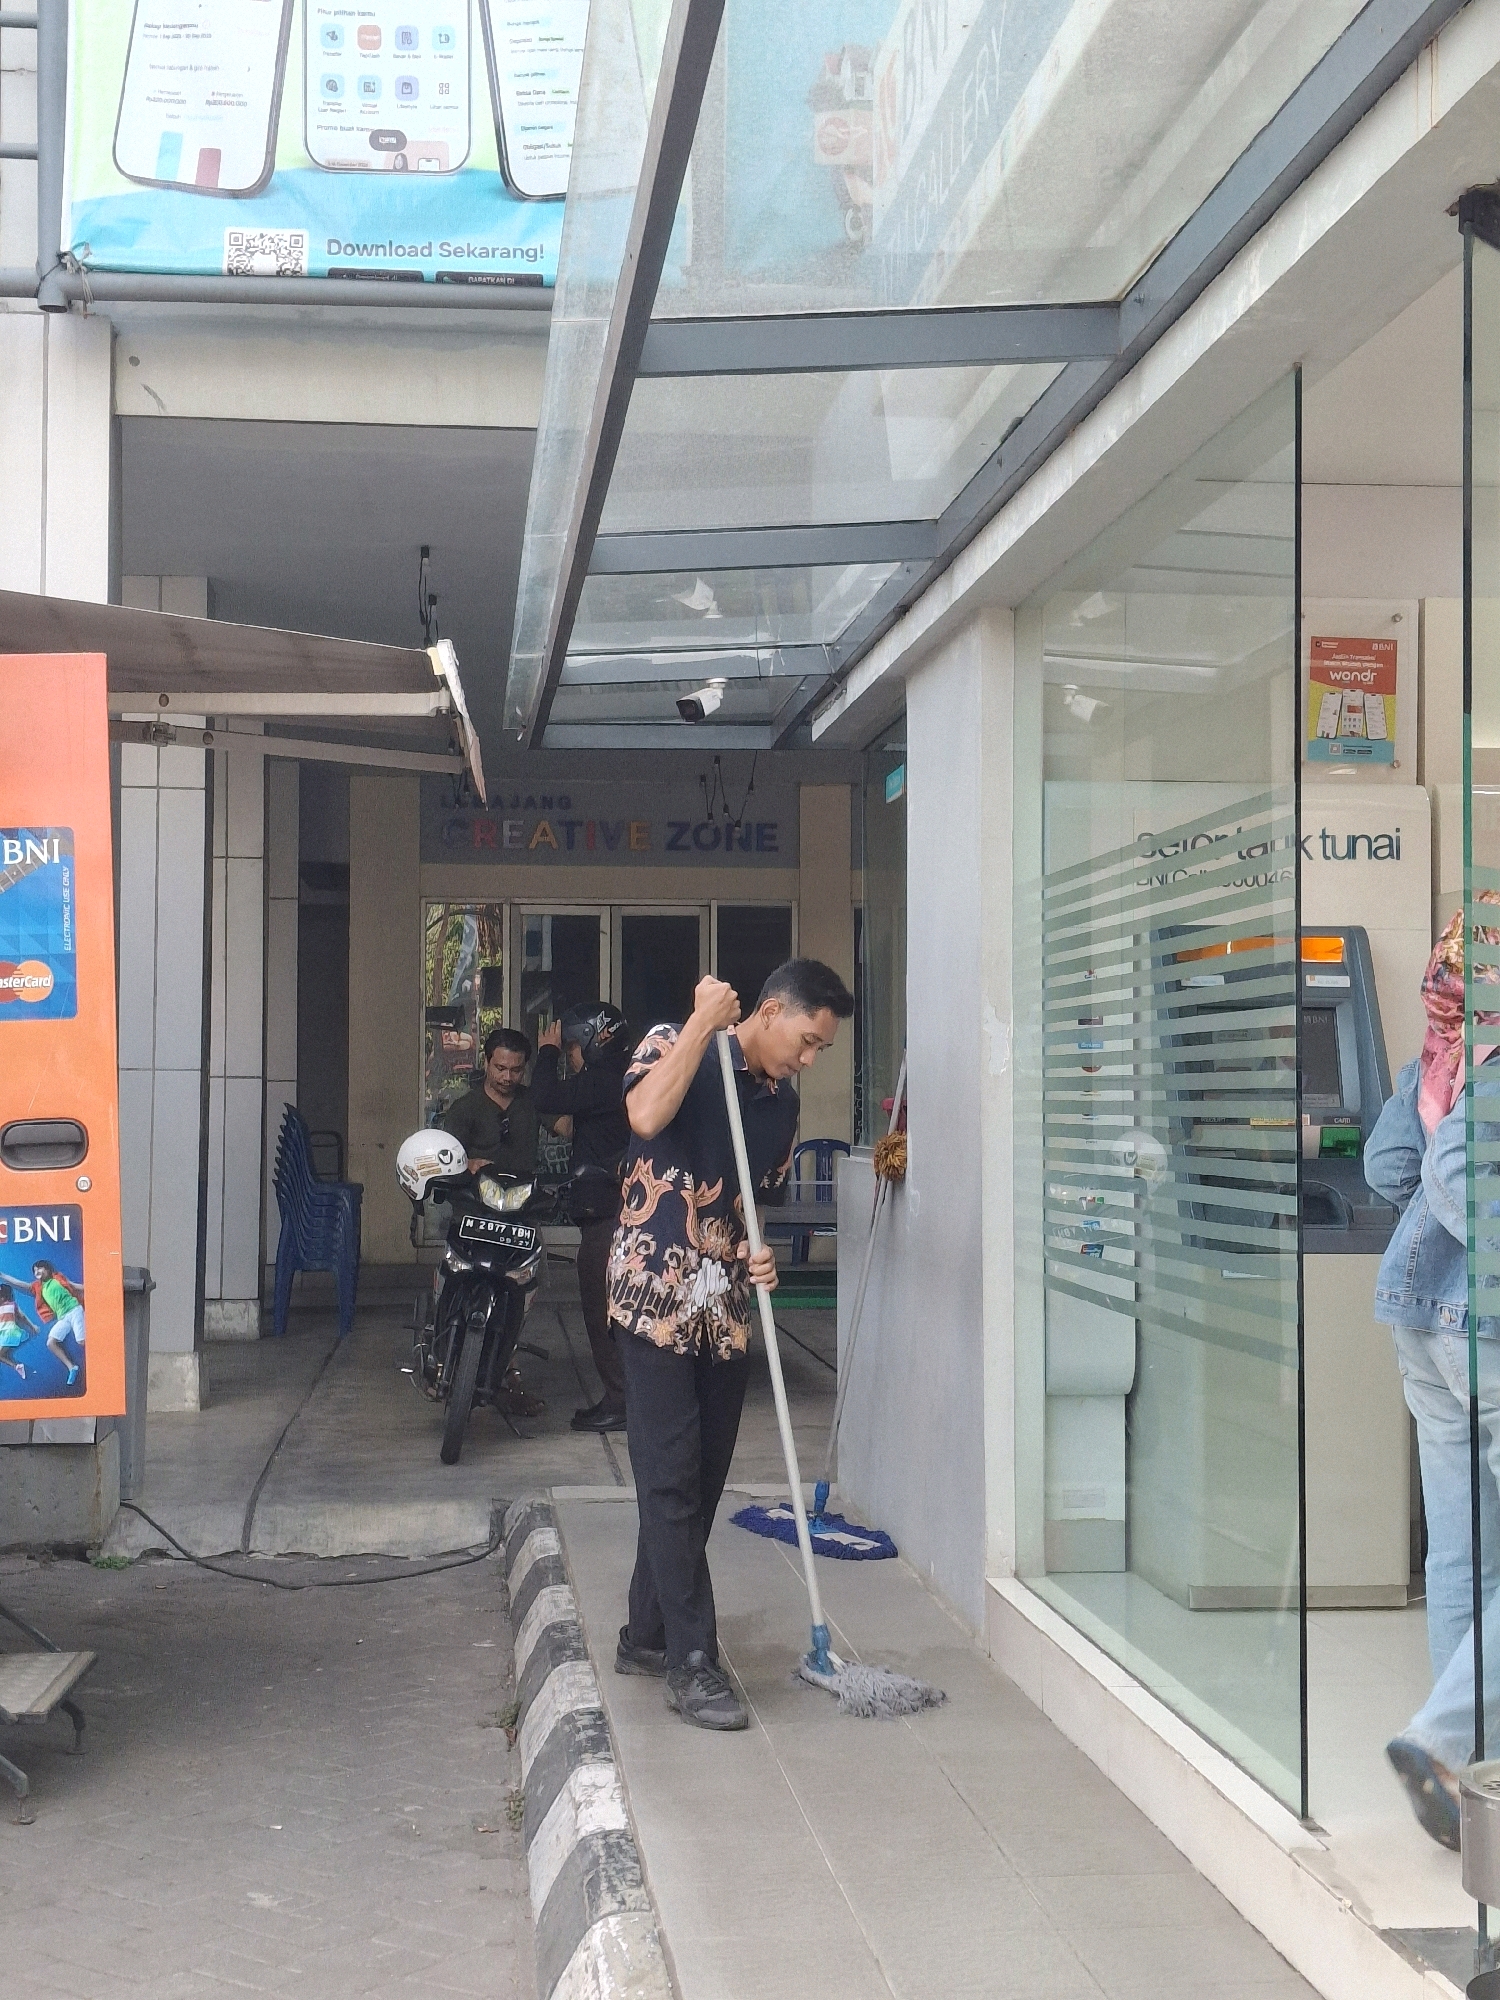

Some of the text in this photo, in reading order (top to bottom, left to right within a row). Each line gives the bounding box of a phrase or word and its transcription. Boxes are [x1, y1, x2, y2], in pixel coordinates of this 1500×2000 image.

[326, 238, 545, 263] Download Sekarang!
[1330, 669, 1377, 682] wondr
[442, 817, 780, 853] CREATIVE ZONE
[1319, 826, 1400, 860] tunai
[3, 838, 60, 865] BNI
[62, 866, 72, 951] ELECTRONIC USE ONLY
[13, 1214, 71, 1243] BNI
[465, 1218, 474, 1228] N
